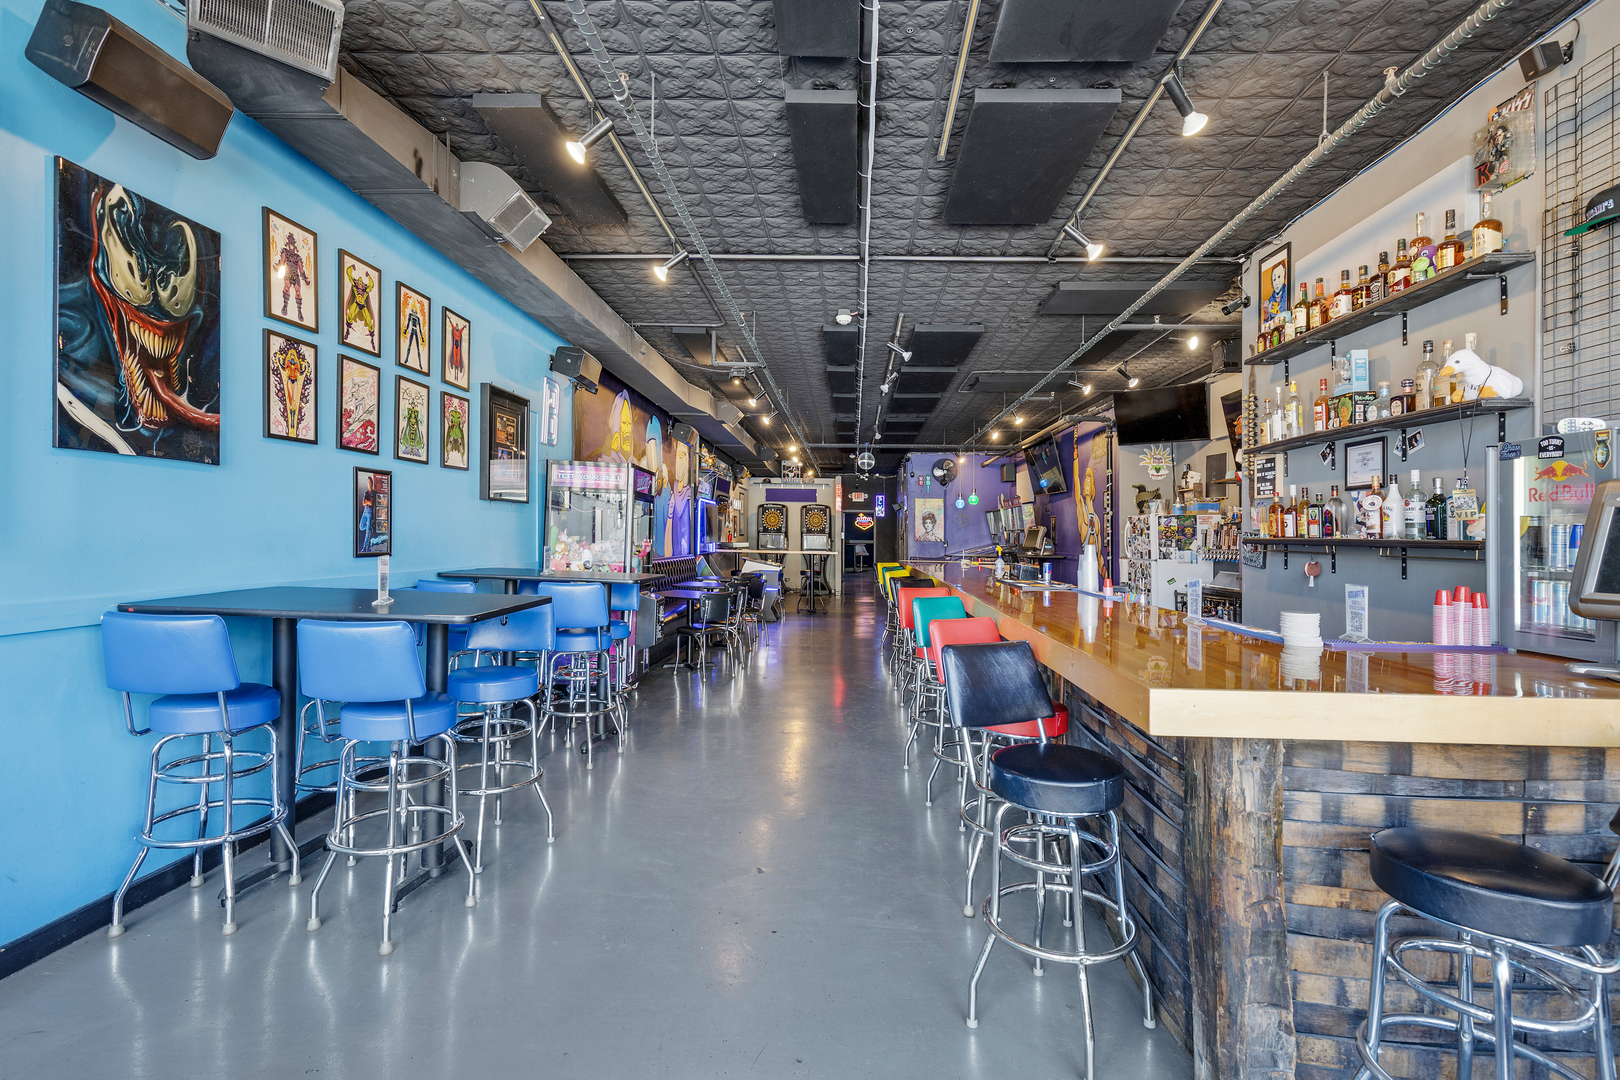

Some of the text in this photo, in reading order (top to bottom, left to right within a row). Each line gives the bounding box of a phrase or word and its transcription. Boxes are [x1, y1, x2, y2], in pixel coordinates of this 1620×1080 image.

[1502, 91, 1533, 115] KISS
[1528, 482, 1595, 502] Red Bull
[1456, 511, 1477, 519] VIP
